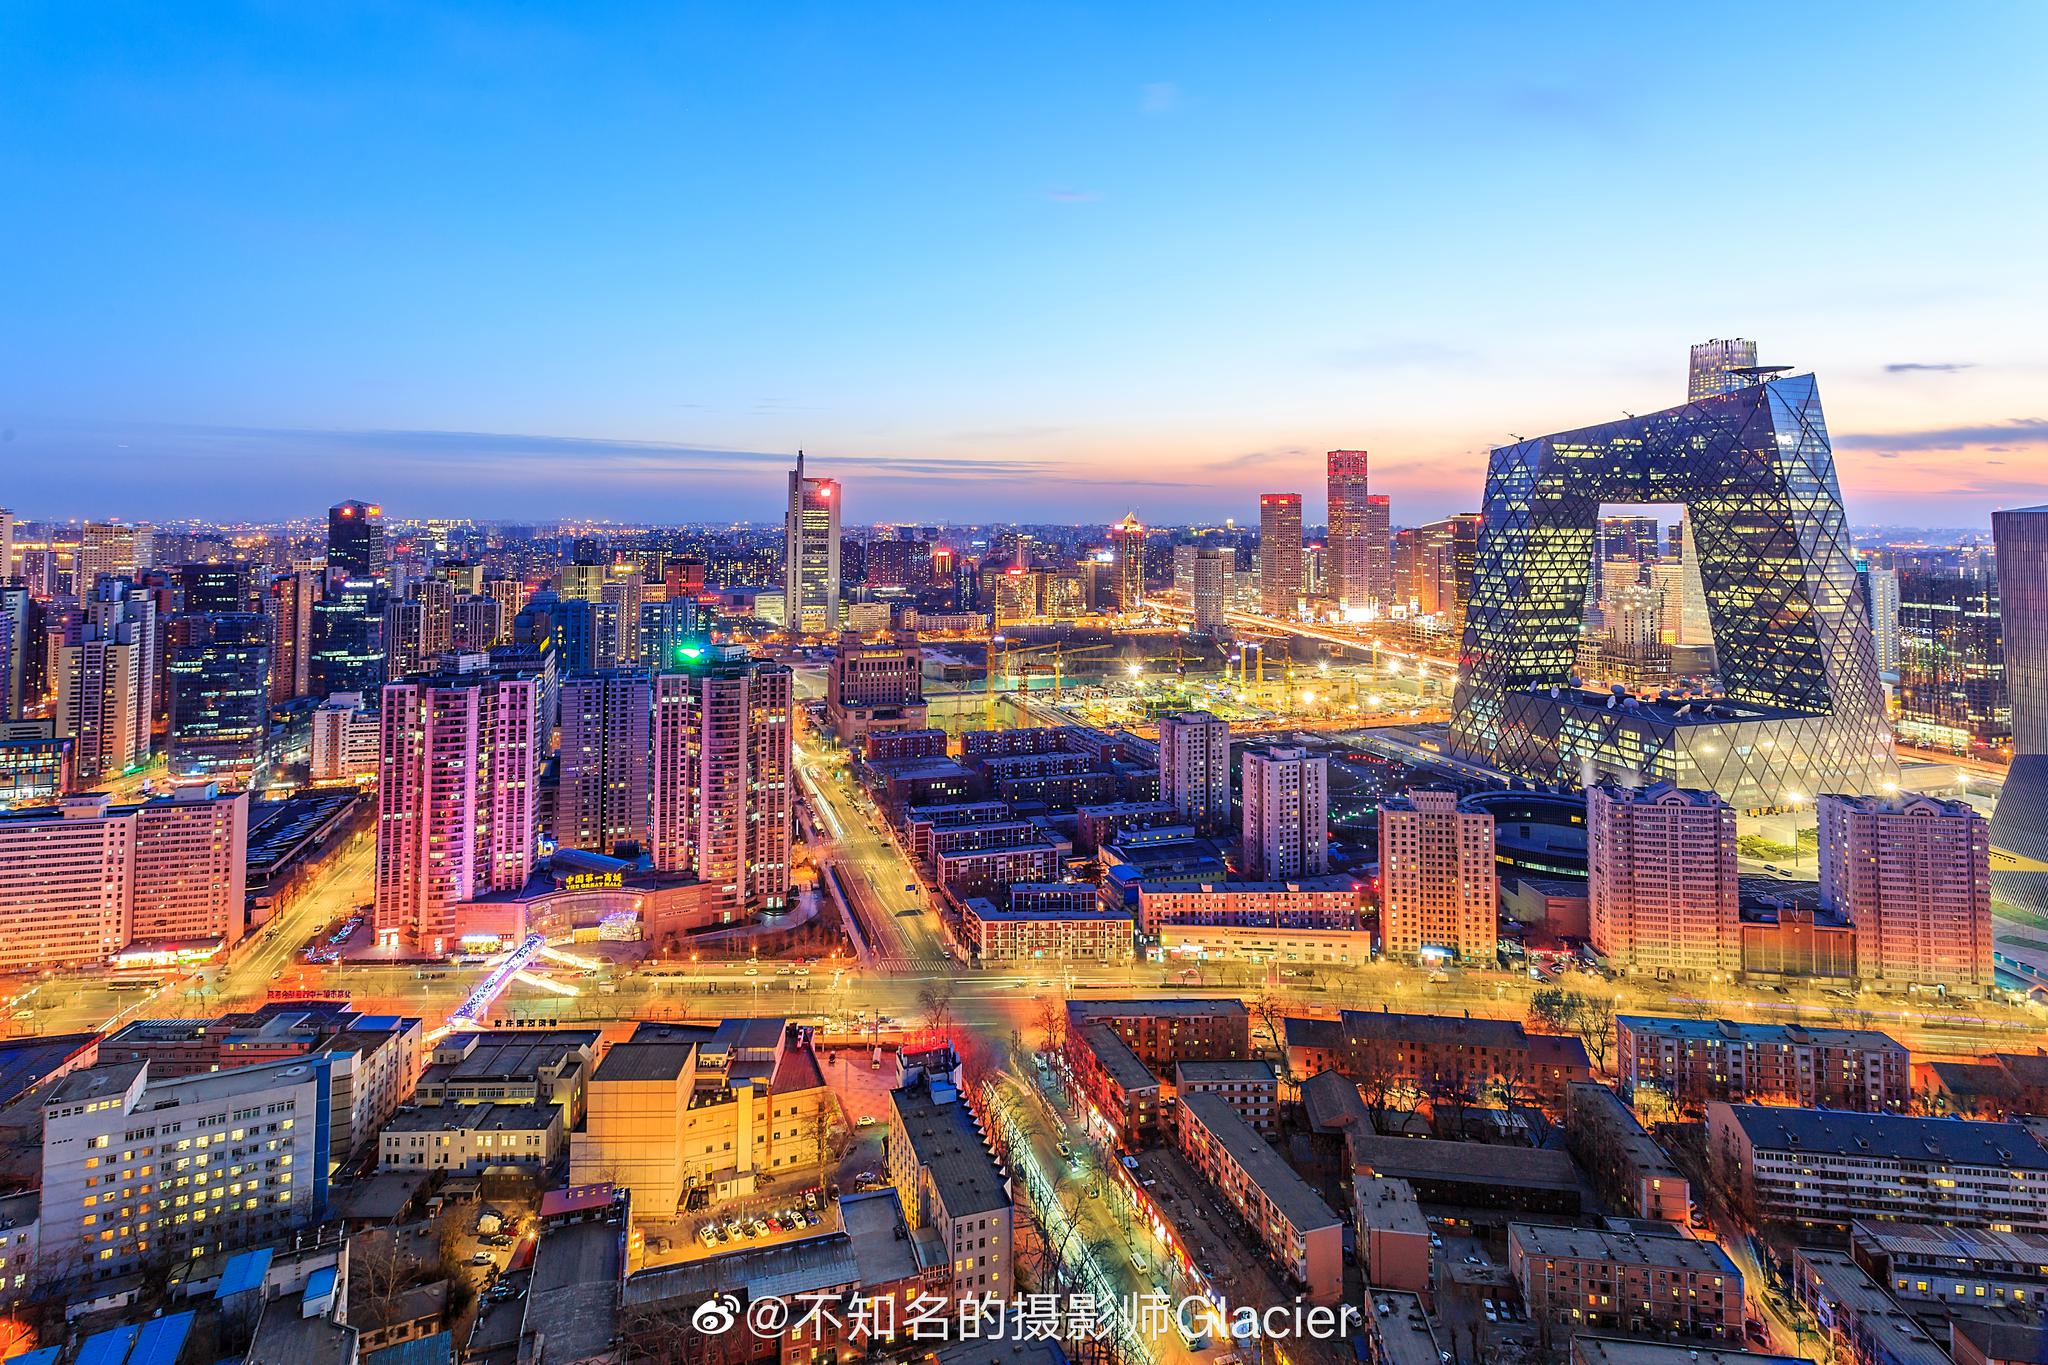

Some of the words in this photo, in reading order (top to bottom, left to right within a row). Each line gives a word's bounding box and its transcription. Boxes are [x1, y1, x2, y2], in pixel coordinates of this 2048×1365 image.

[565, 872, 622, 885] 中国第一商城
